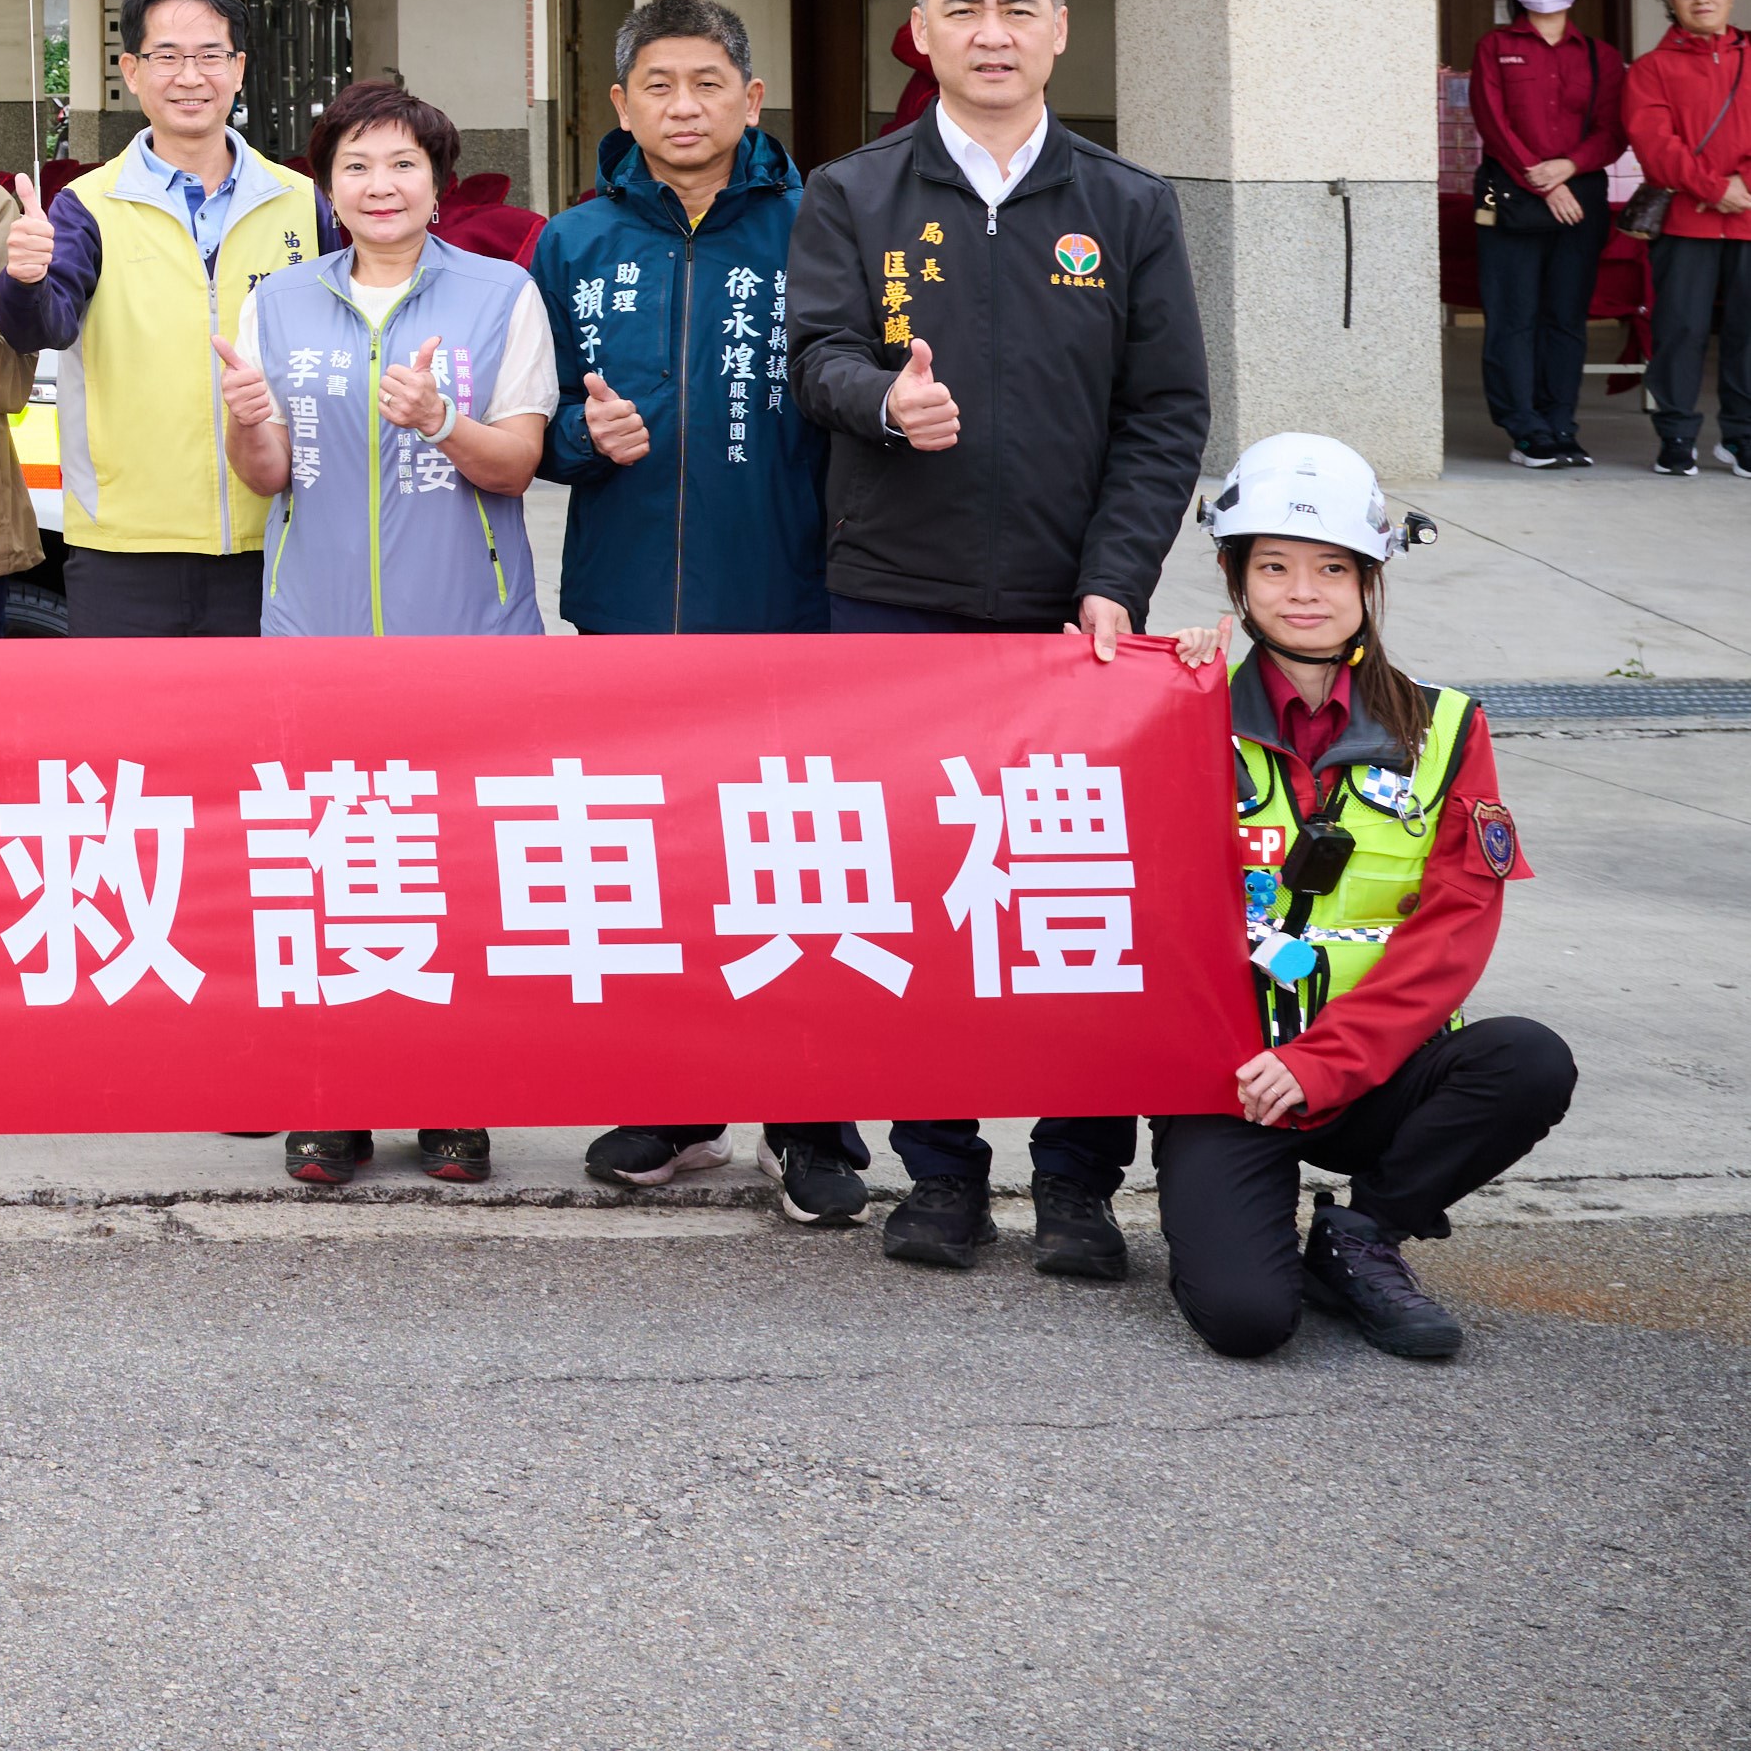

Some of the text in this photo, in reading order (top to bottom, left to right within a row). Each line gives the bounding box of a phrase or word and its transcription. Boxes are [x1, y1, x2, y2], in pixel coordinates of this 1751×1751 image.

[611, 262, 641, 312] 助理
[919, 221, 946, 283] 局長
[572, 278, 605, 380] 賴子
[881, 250, 914, 348] 匡夢麟
[325, 349, 352, 397] 秘書
[720, 267, 764, 464] 徐永煌 服務團隊
[287, 347, 324, 489] 李碧琴
[398, 433, 415, 494] 服務團隊
